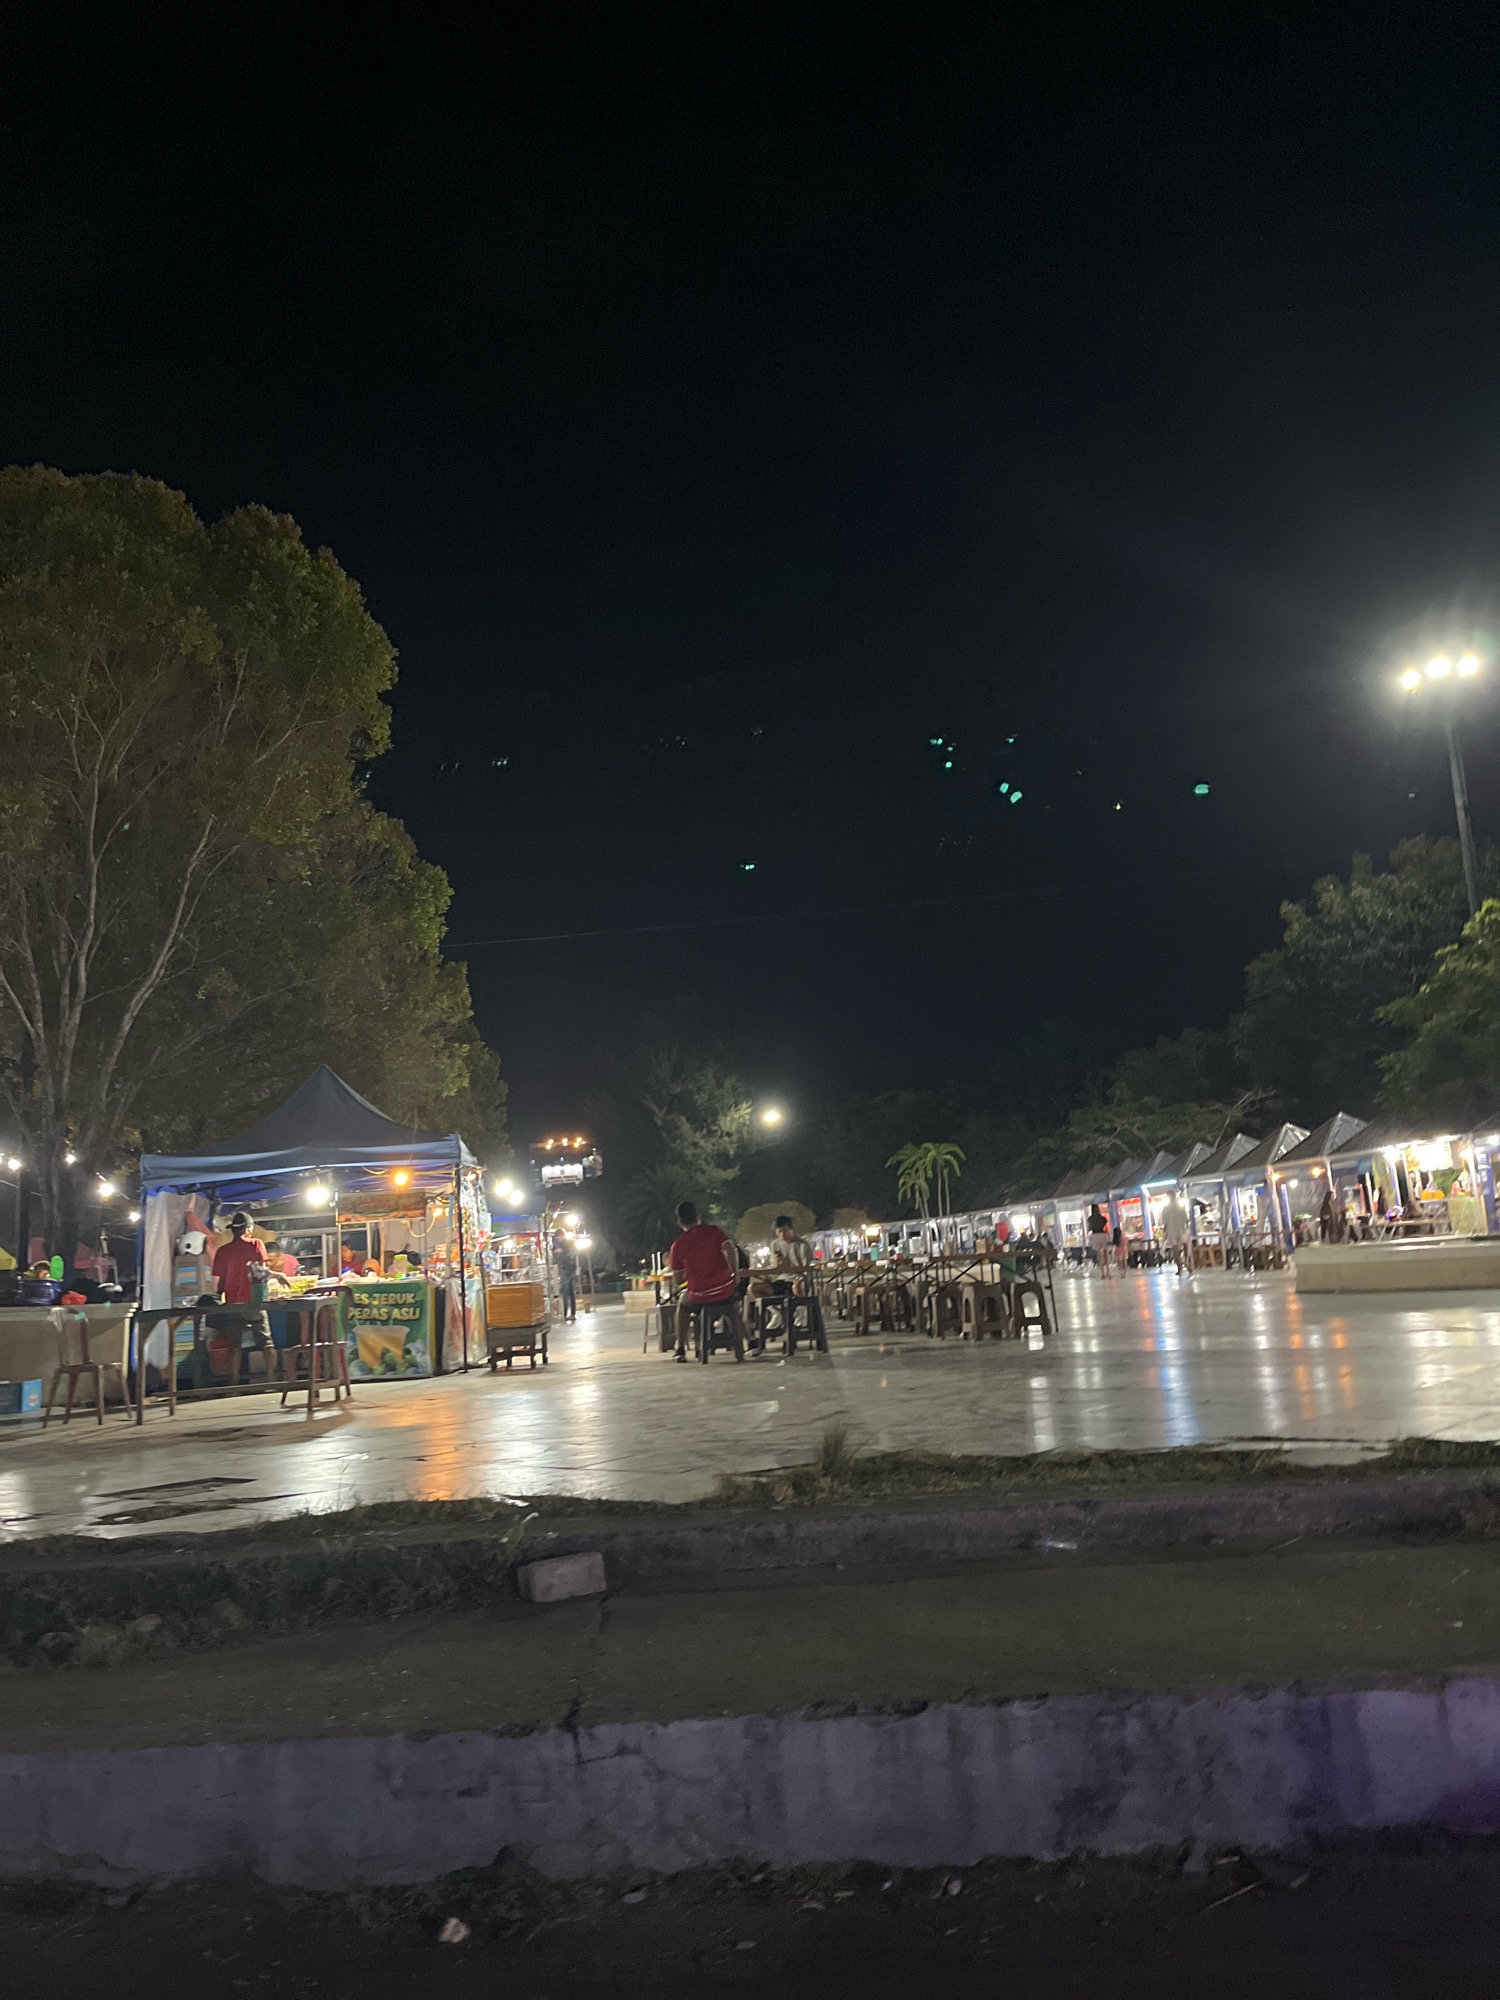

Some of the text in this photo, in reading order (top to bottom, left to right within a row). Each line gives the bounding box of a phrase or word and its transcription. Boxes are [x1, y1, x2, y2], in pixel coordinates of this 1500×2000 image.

[354, 1292, 416, 1305] ES JERUK
[347, 1307, 389, 1321] PERAS
